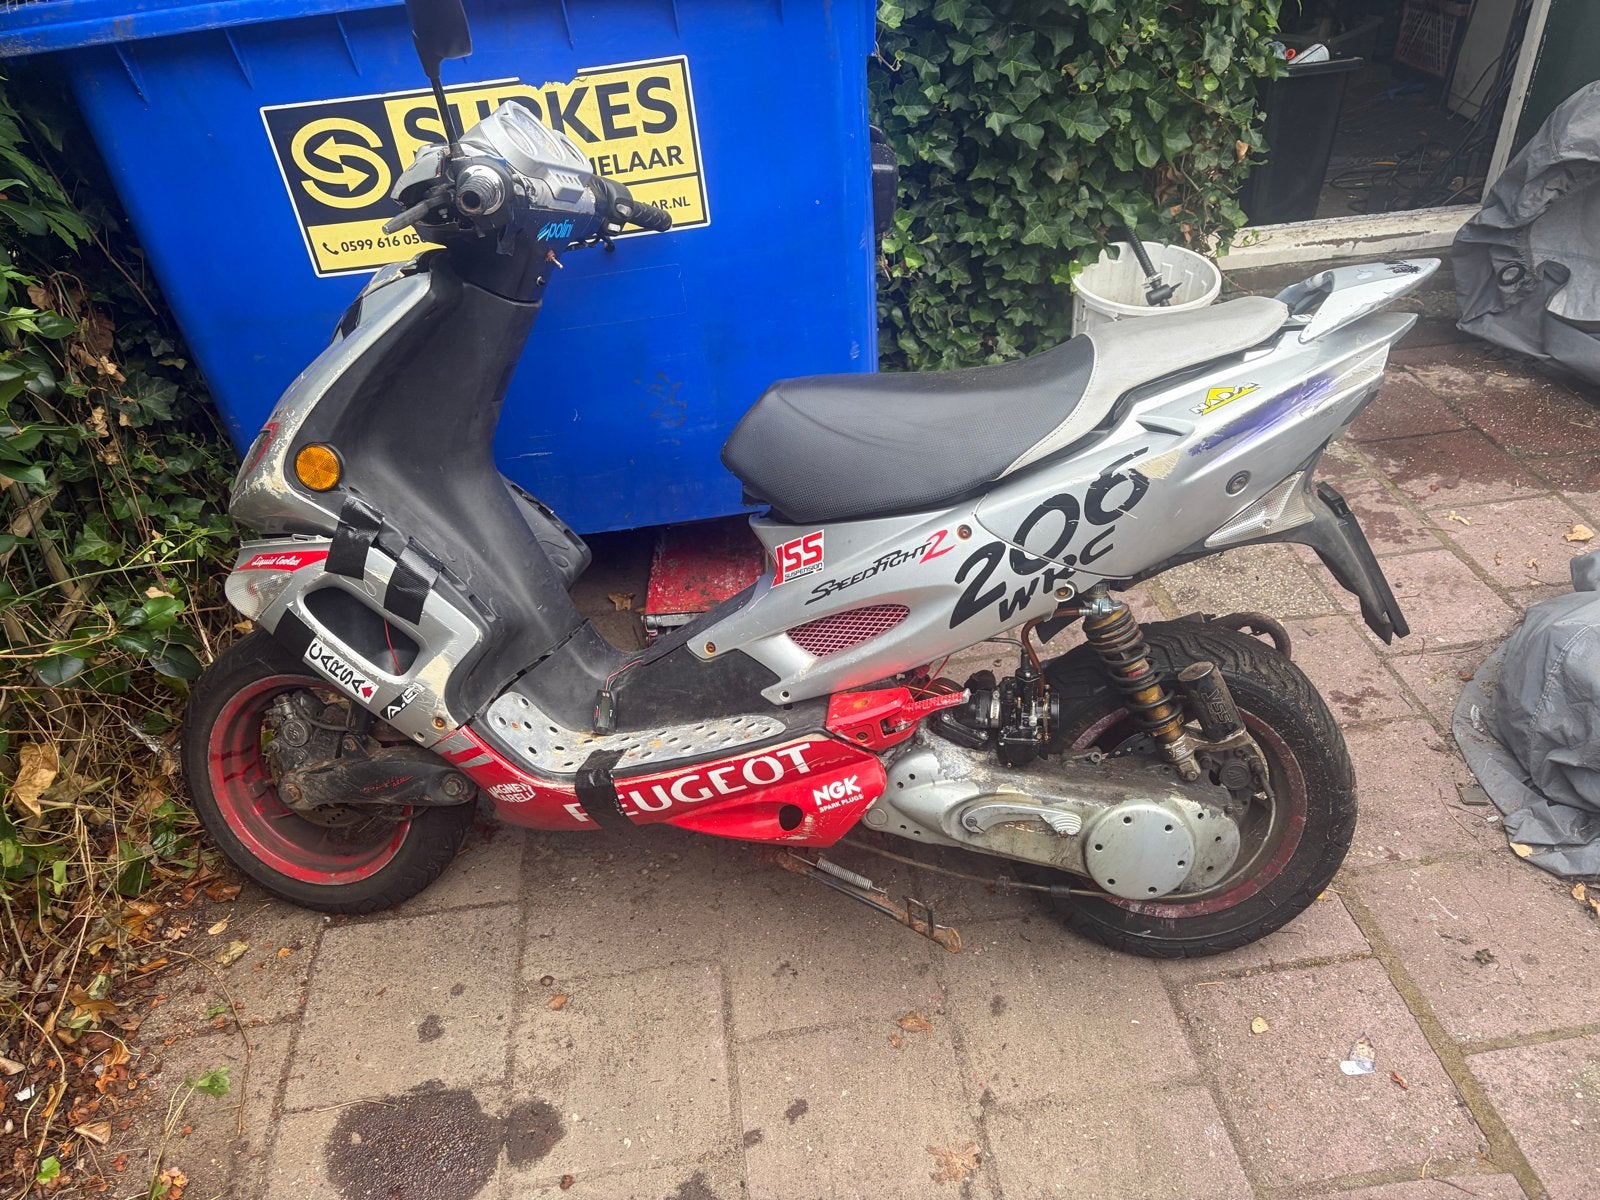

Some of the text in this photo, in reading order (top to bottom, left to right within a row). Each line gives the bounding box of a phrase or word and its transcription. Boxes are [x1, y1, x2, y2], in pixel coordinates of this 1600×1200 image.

[589, 145, 685, 176] ELAAR
[340, 238, 373, 253] 0599
[377, 235, 401, 249] 616
[918, 529, 957, 565] 2
[949, 446, 1150, 630] 206
[309, 642, 366, 694] CARSA
[812, 774, 862, 806] NGK
[819, 793, 864, 813] SPARK PLUGS
